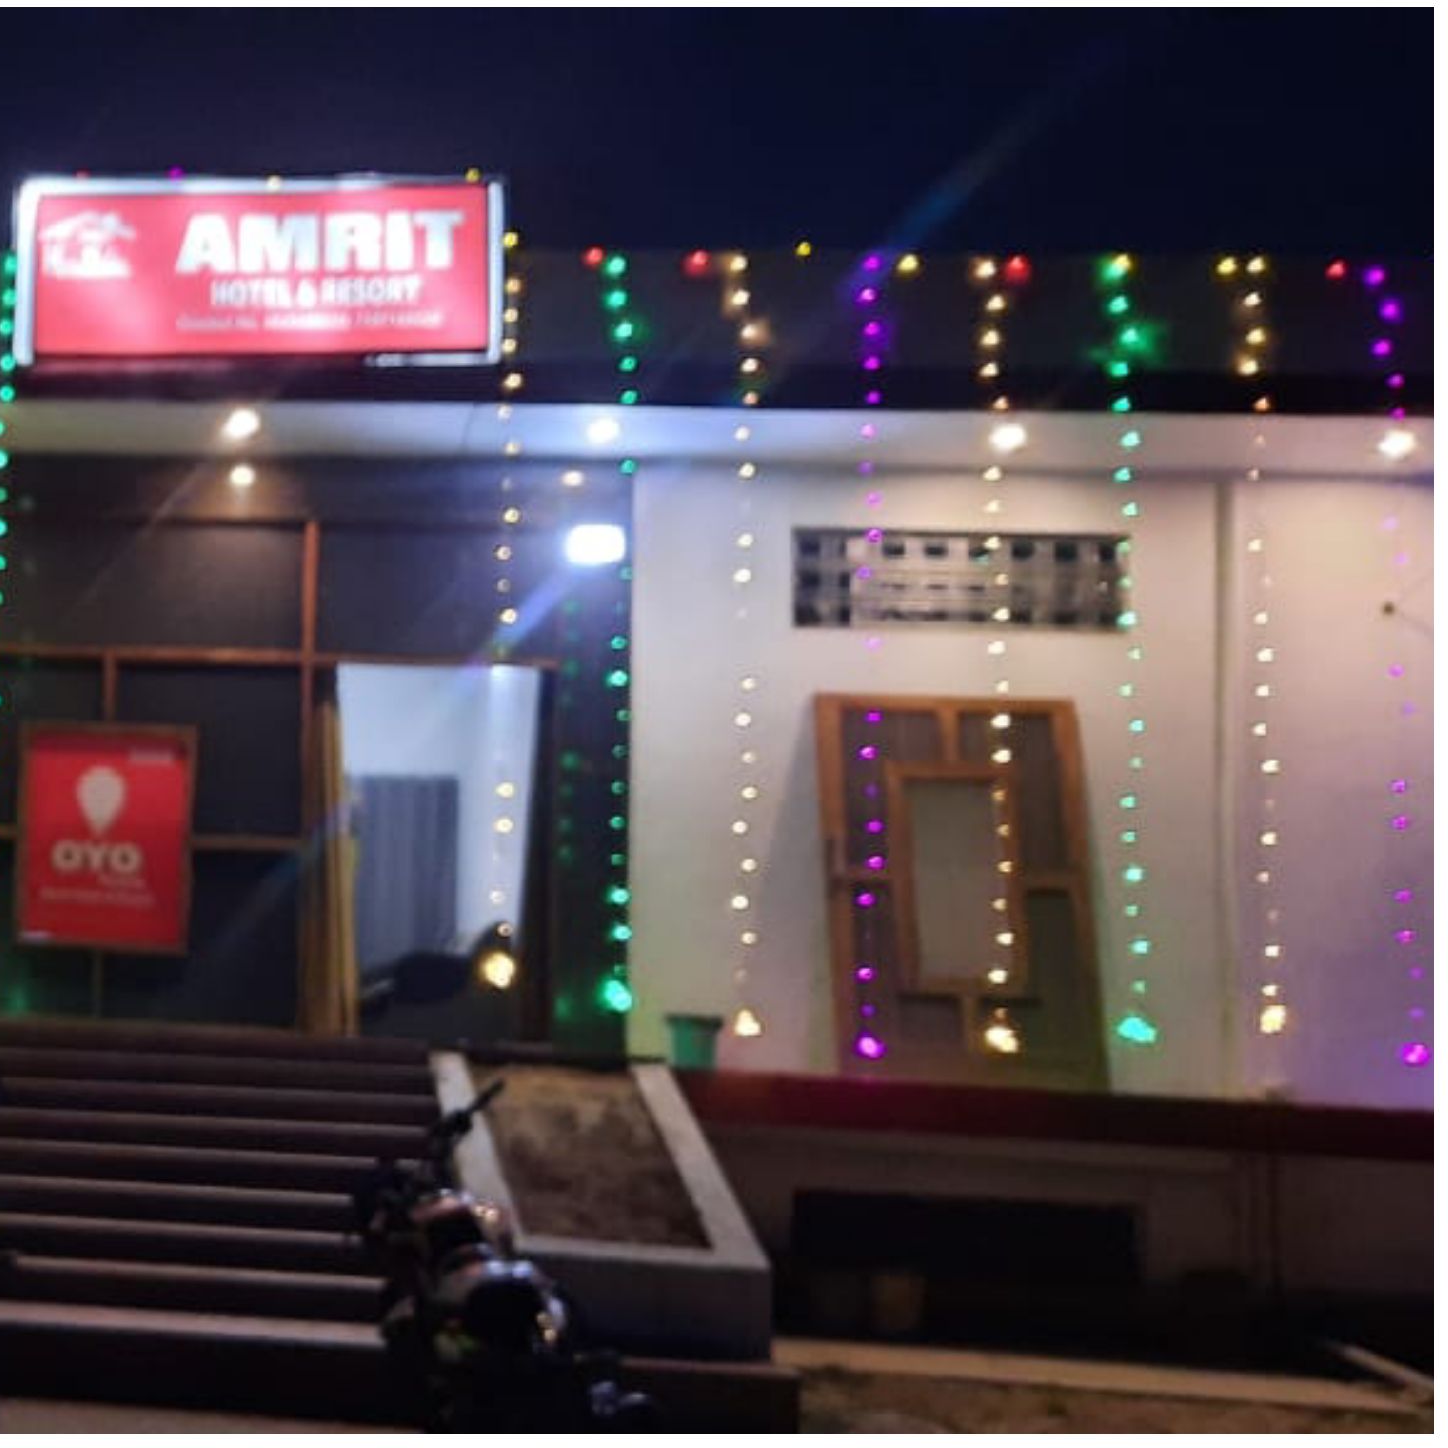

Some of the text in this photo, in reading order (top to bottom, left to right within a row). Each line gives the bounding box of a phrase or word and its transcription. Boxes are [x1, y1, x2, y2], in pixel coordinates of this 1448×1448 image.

[177, 211, 462, 273] AMRIT
[212, 278, 291, 306] HOTEL
[321, 275, 421, 304] RESORT
[51, 839, 142, 872] OYO
